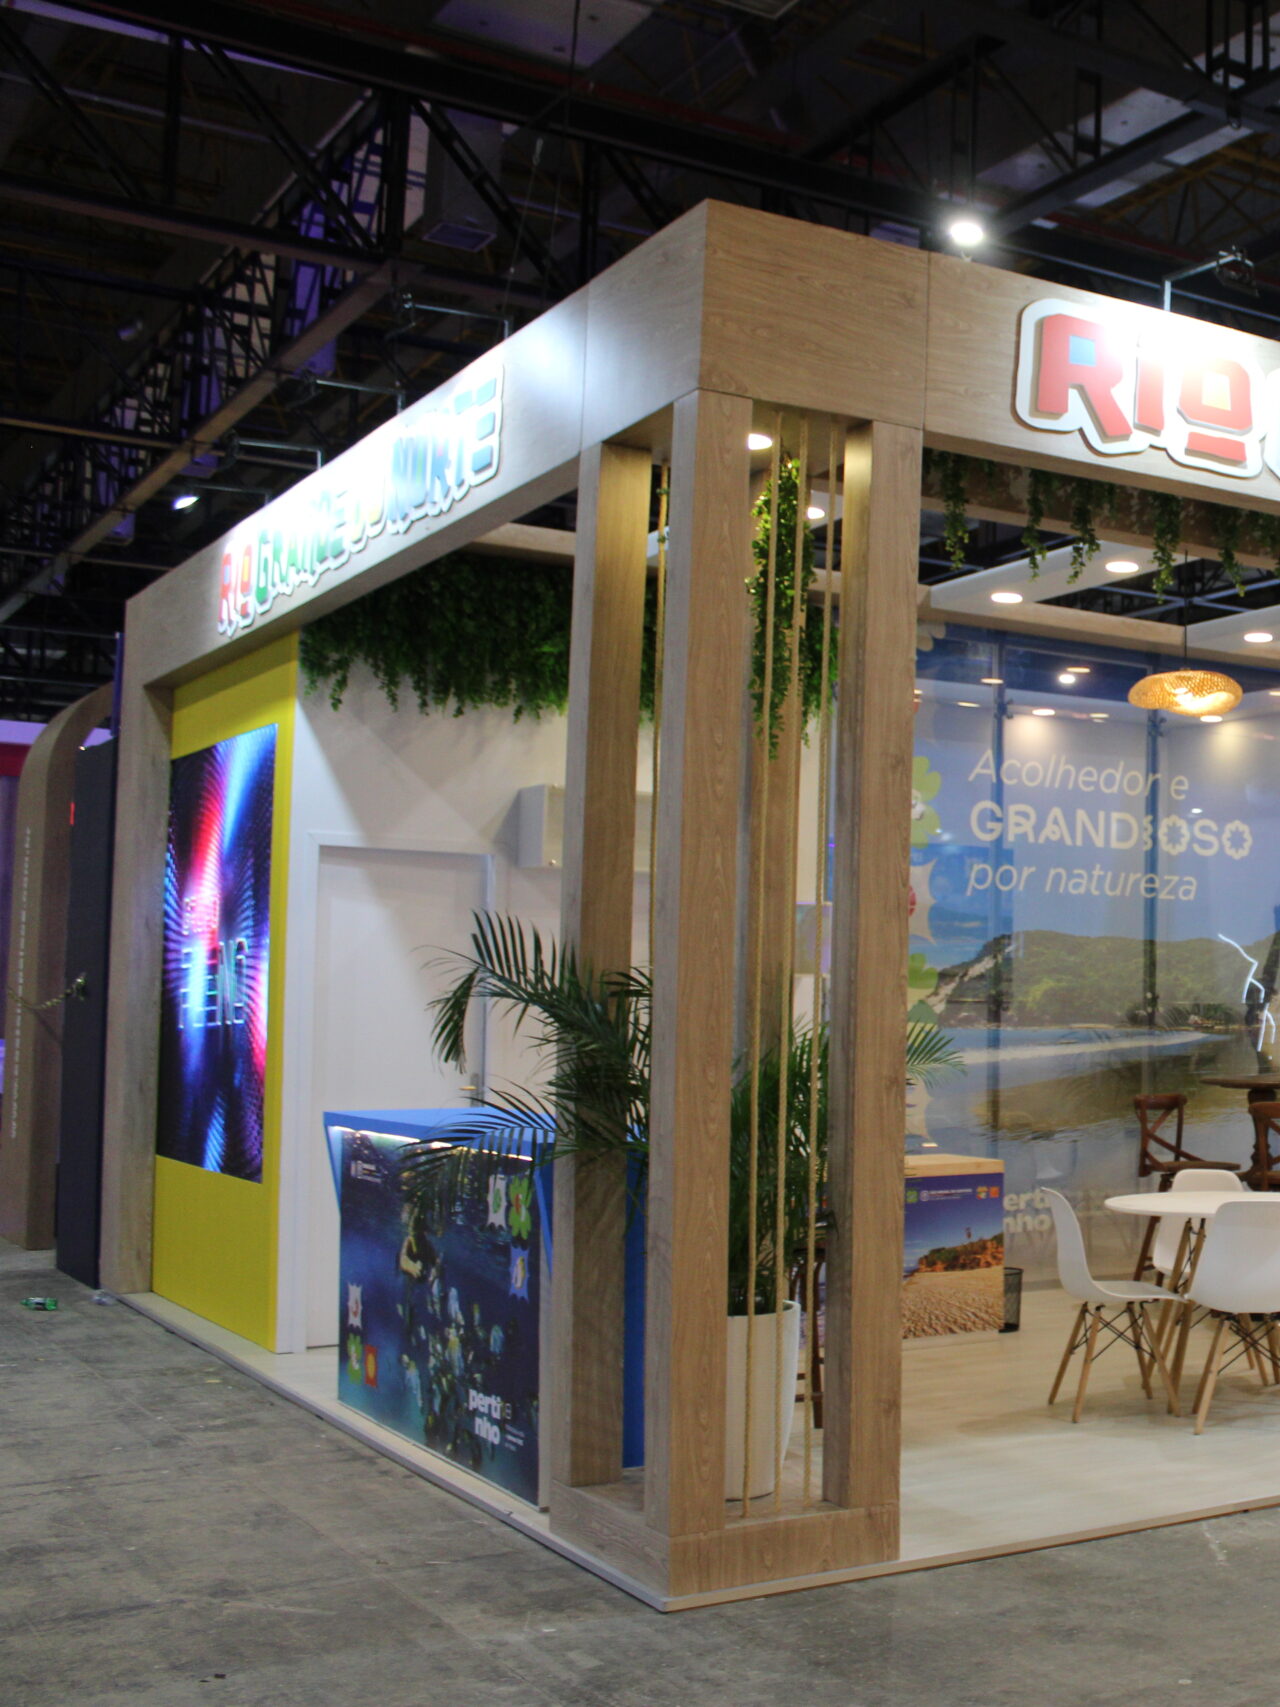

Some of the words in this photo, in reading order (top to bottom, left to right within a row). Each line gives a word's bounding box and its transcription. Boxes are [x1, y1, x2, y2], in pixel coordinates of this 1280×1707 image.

[1036, 312, 1253, 464] RIO
[968, 749, 1162, 797] Acolhedor
[1169, 775, 1190, 800] e
[966, 863, 1036, 896] por
[1045, 864, 1197, 901] natureza
